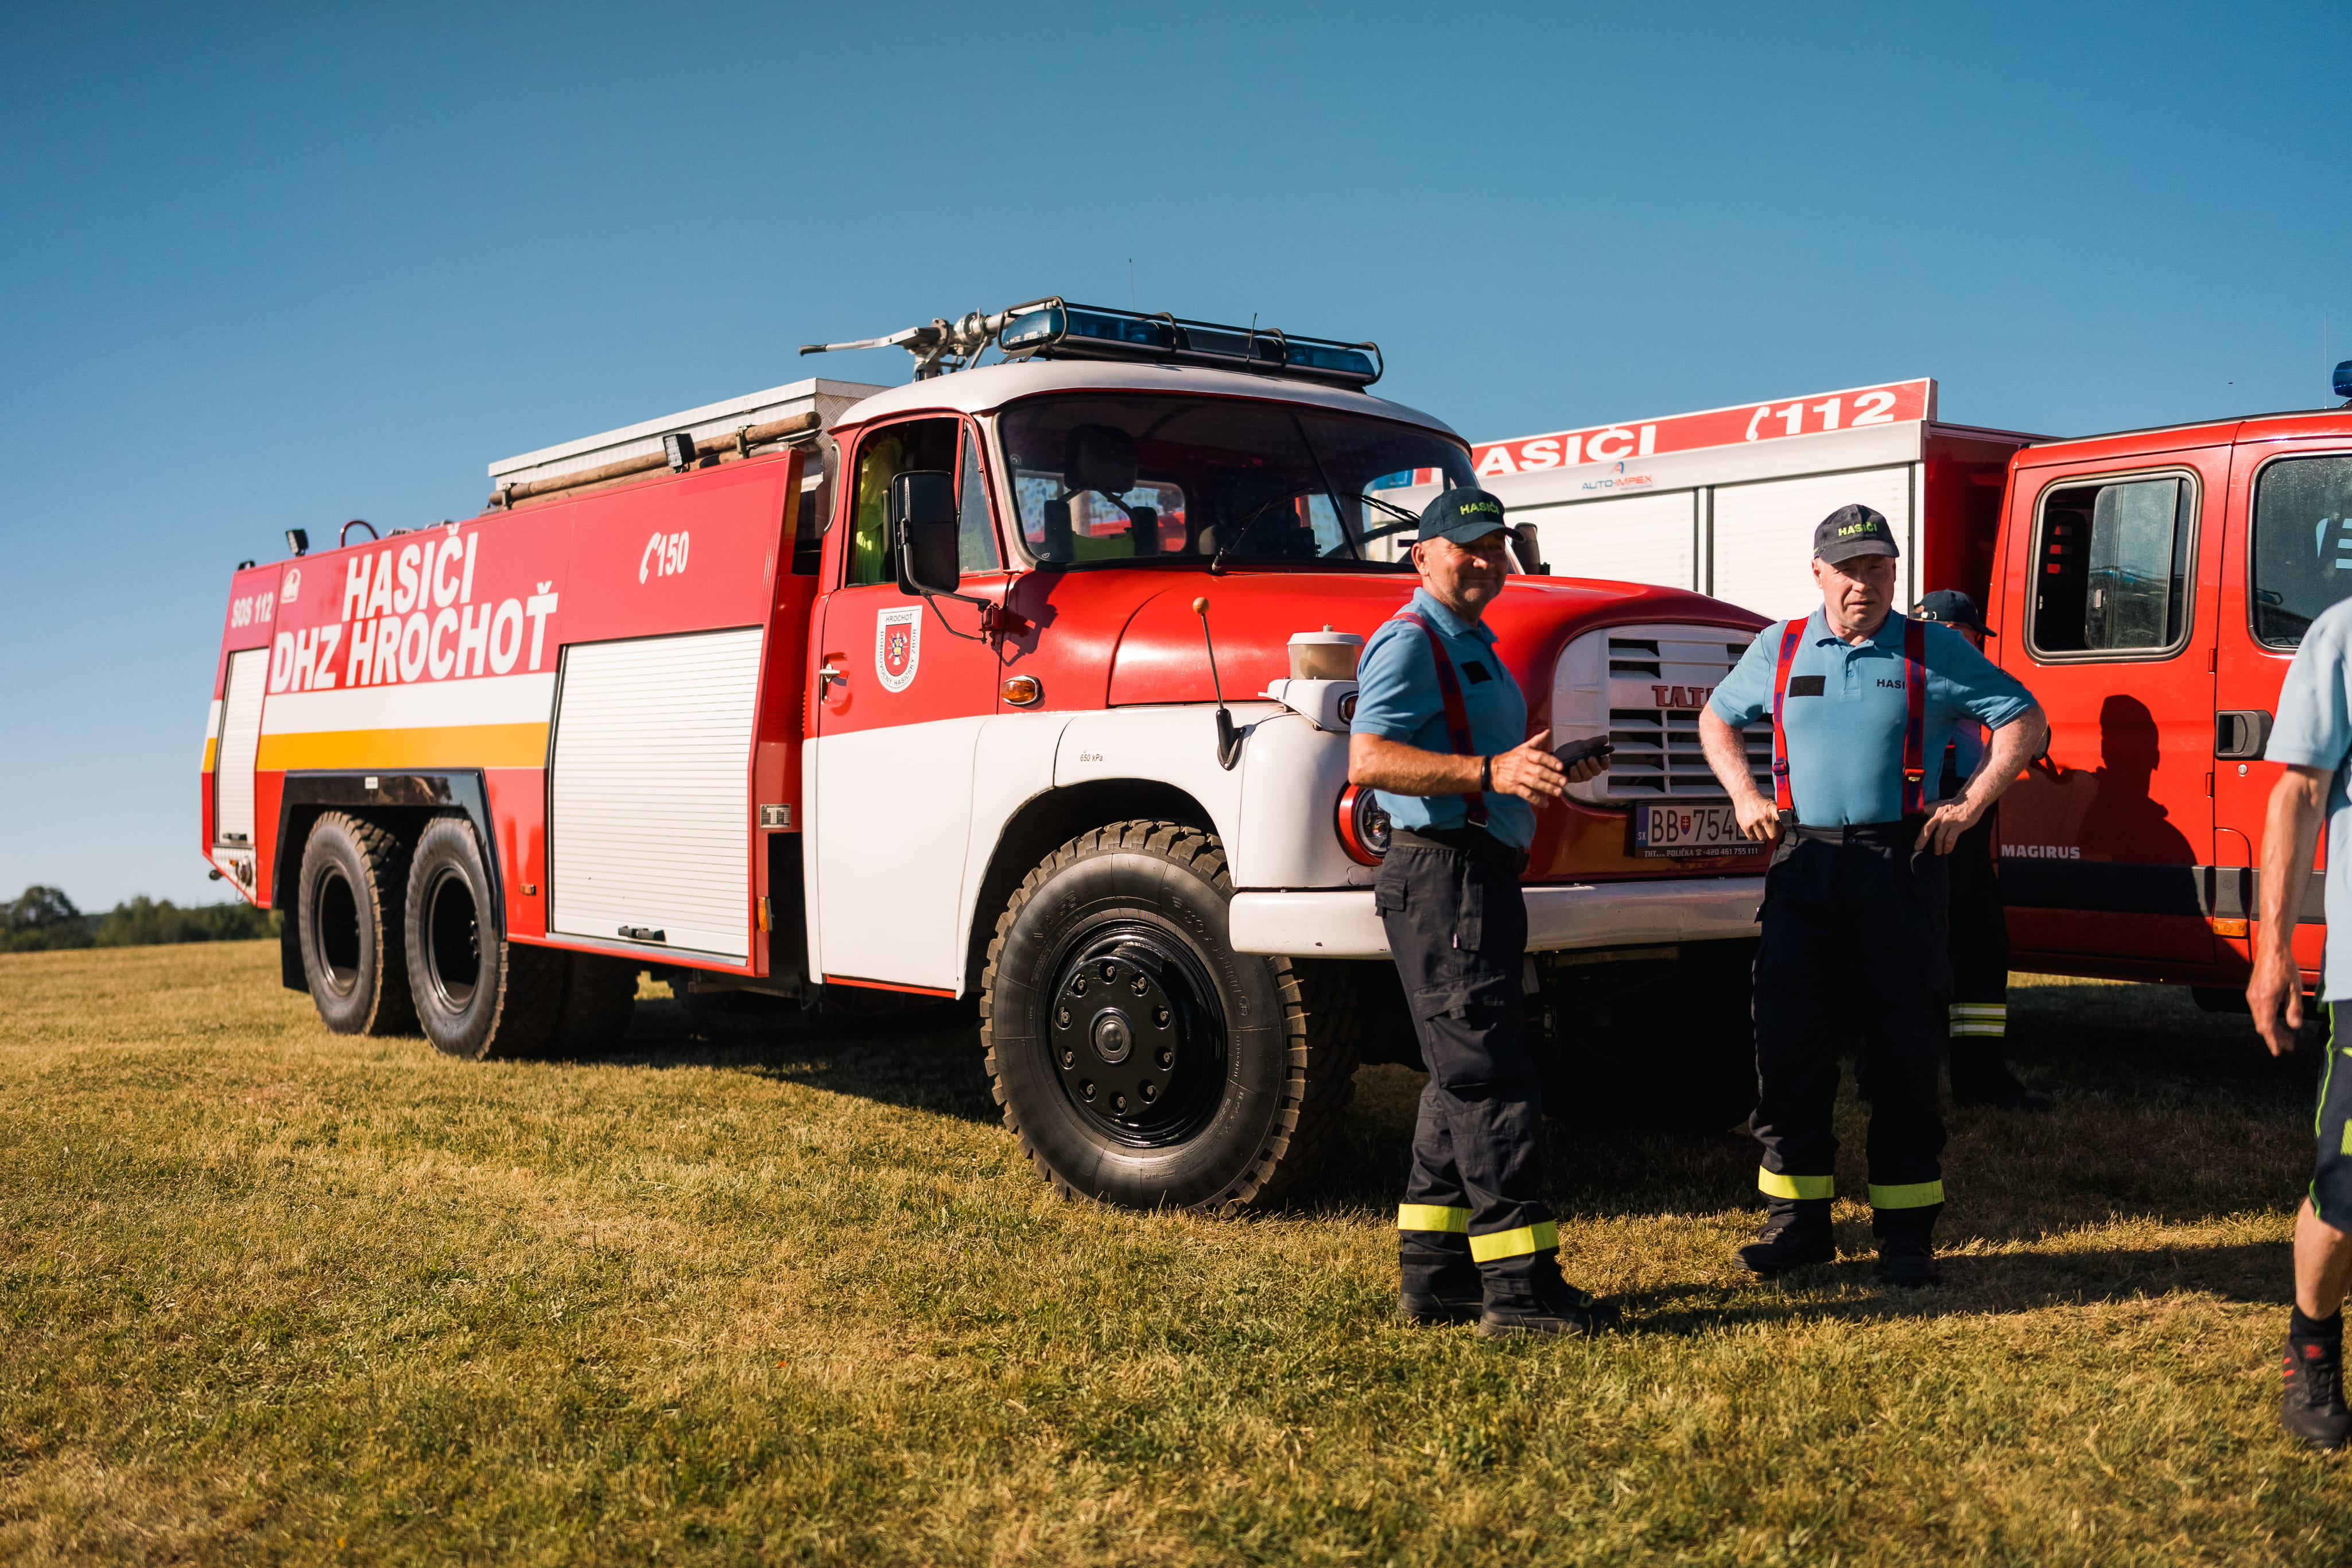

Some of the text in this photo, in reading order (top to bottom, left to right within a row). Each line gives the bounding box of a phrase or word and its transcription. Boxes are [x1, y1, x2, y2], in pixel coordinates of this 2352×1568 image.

[1431, 391, 1896, 483] ASIČI 112
[1582, 475, 1652, 490] AUTO-IMPEX
[1838, 522, 1877, 536] HASIČI
[657, 531, 689, 577] 150
[341, 523, 478, 622] HASIČI
[231, 592, 273, 628] SOS 112
[270, 581, 559, 694] DHZ HROCHOŤ
[1877, 679, 1906, 689] HASI
[1092, 754, 1103, 762] kPa
[1652, 810, 1679, 843] BB
[1638, 832, 1646, 840] SK
[1667, 848, 1694, 857] POLIČKA
[2001, 844, 2080, 859] MAGIRUS
